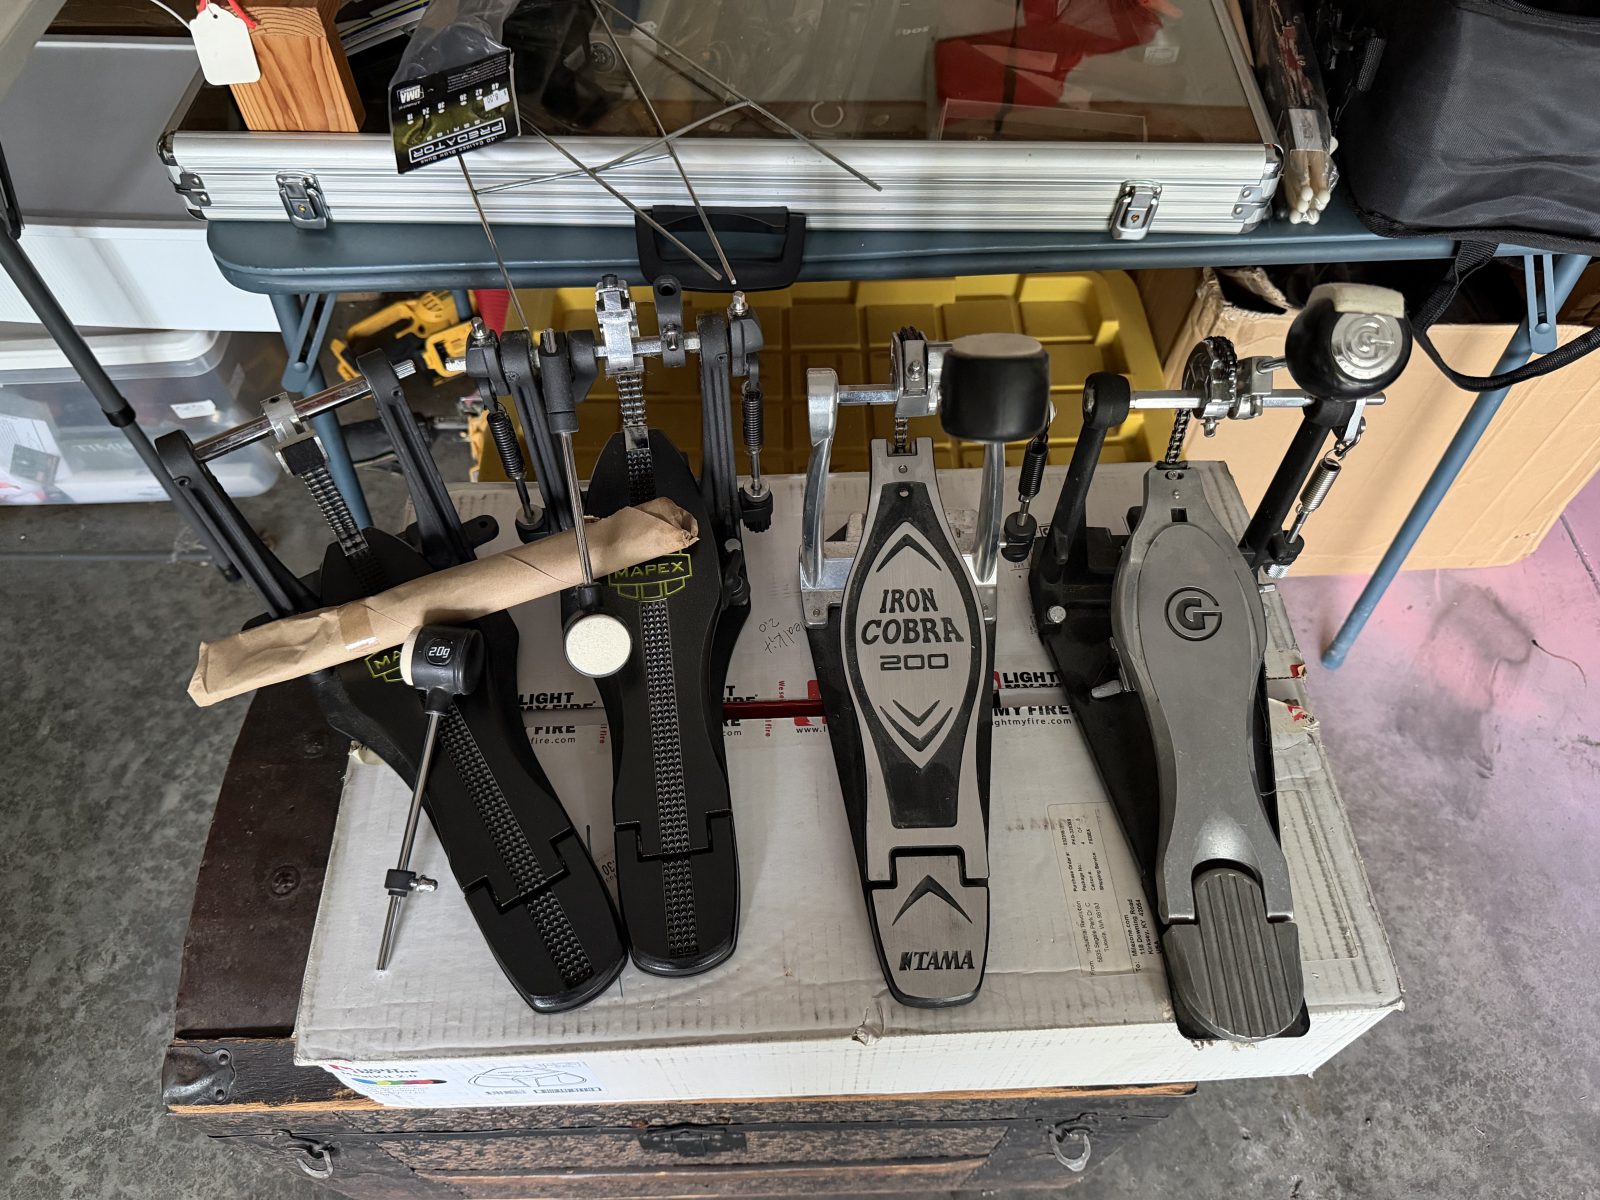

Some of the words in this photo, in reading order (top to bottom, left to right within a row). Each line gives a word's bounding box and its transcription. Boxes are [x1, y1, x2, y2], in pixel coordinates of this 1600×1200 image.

[427, 120, 480, 140] SERIES
[413, 122, 502, 158] PREDATOR
[614, 561, 684, 580] MAPEX
[880, 587, 938, 614] IRON
[861, 617, 964, 645] COBRA
[429, 646, 451, 658] 20g
[880, 653, 949, 671] 200
[1003, 672, 1057, 683] LIGHT
[519, 692, 574, 705] LIGHT
[993, 706, 1021, 716] MY
[1127, 899, 1135, 915] Road
[1132, 916, 1142, 943] Downing
[1141, 919, 1147, 928] KY
[1124, 915, 1137, 956] Milezone.com
[913, 949, 975, 971] TAMA
